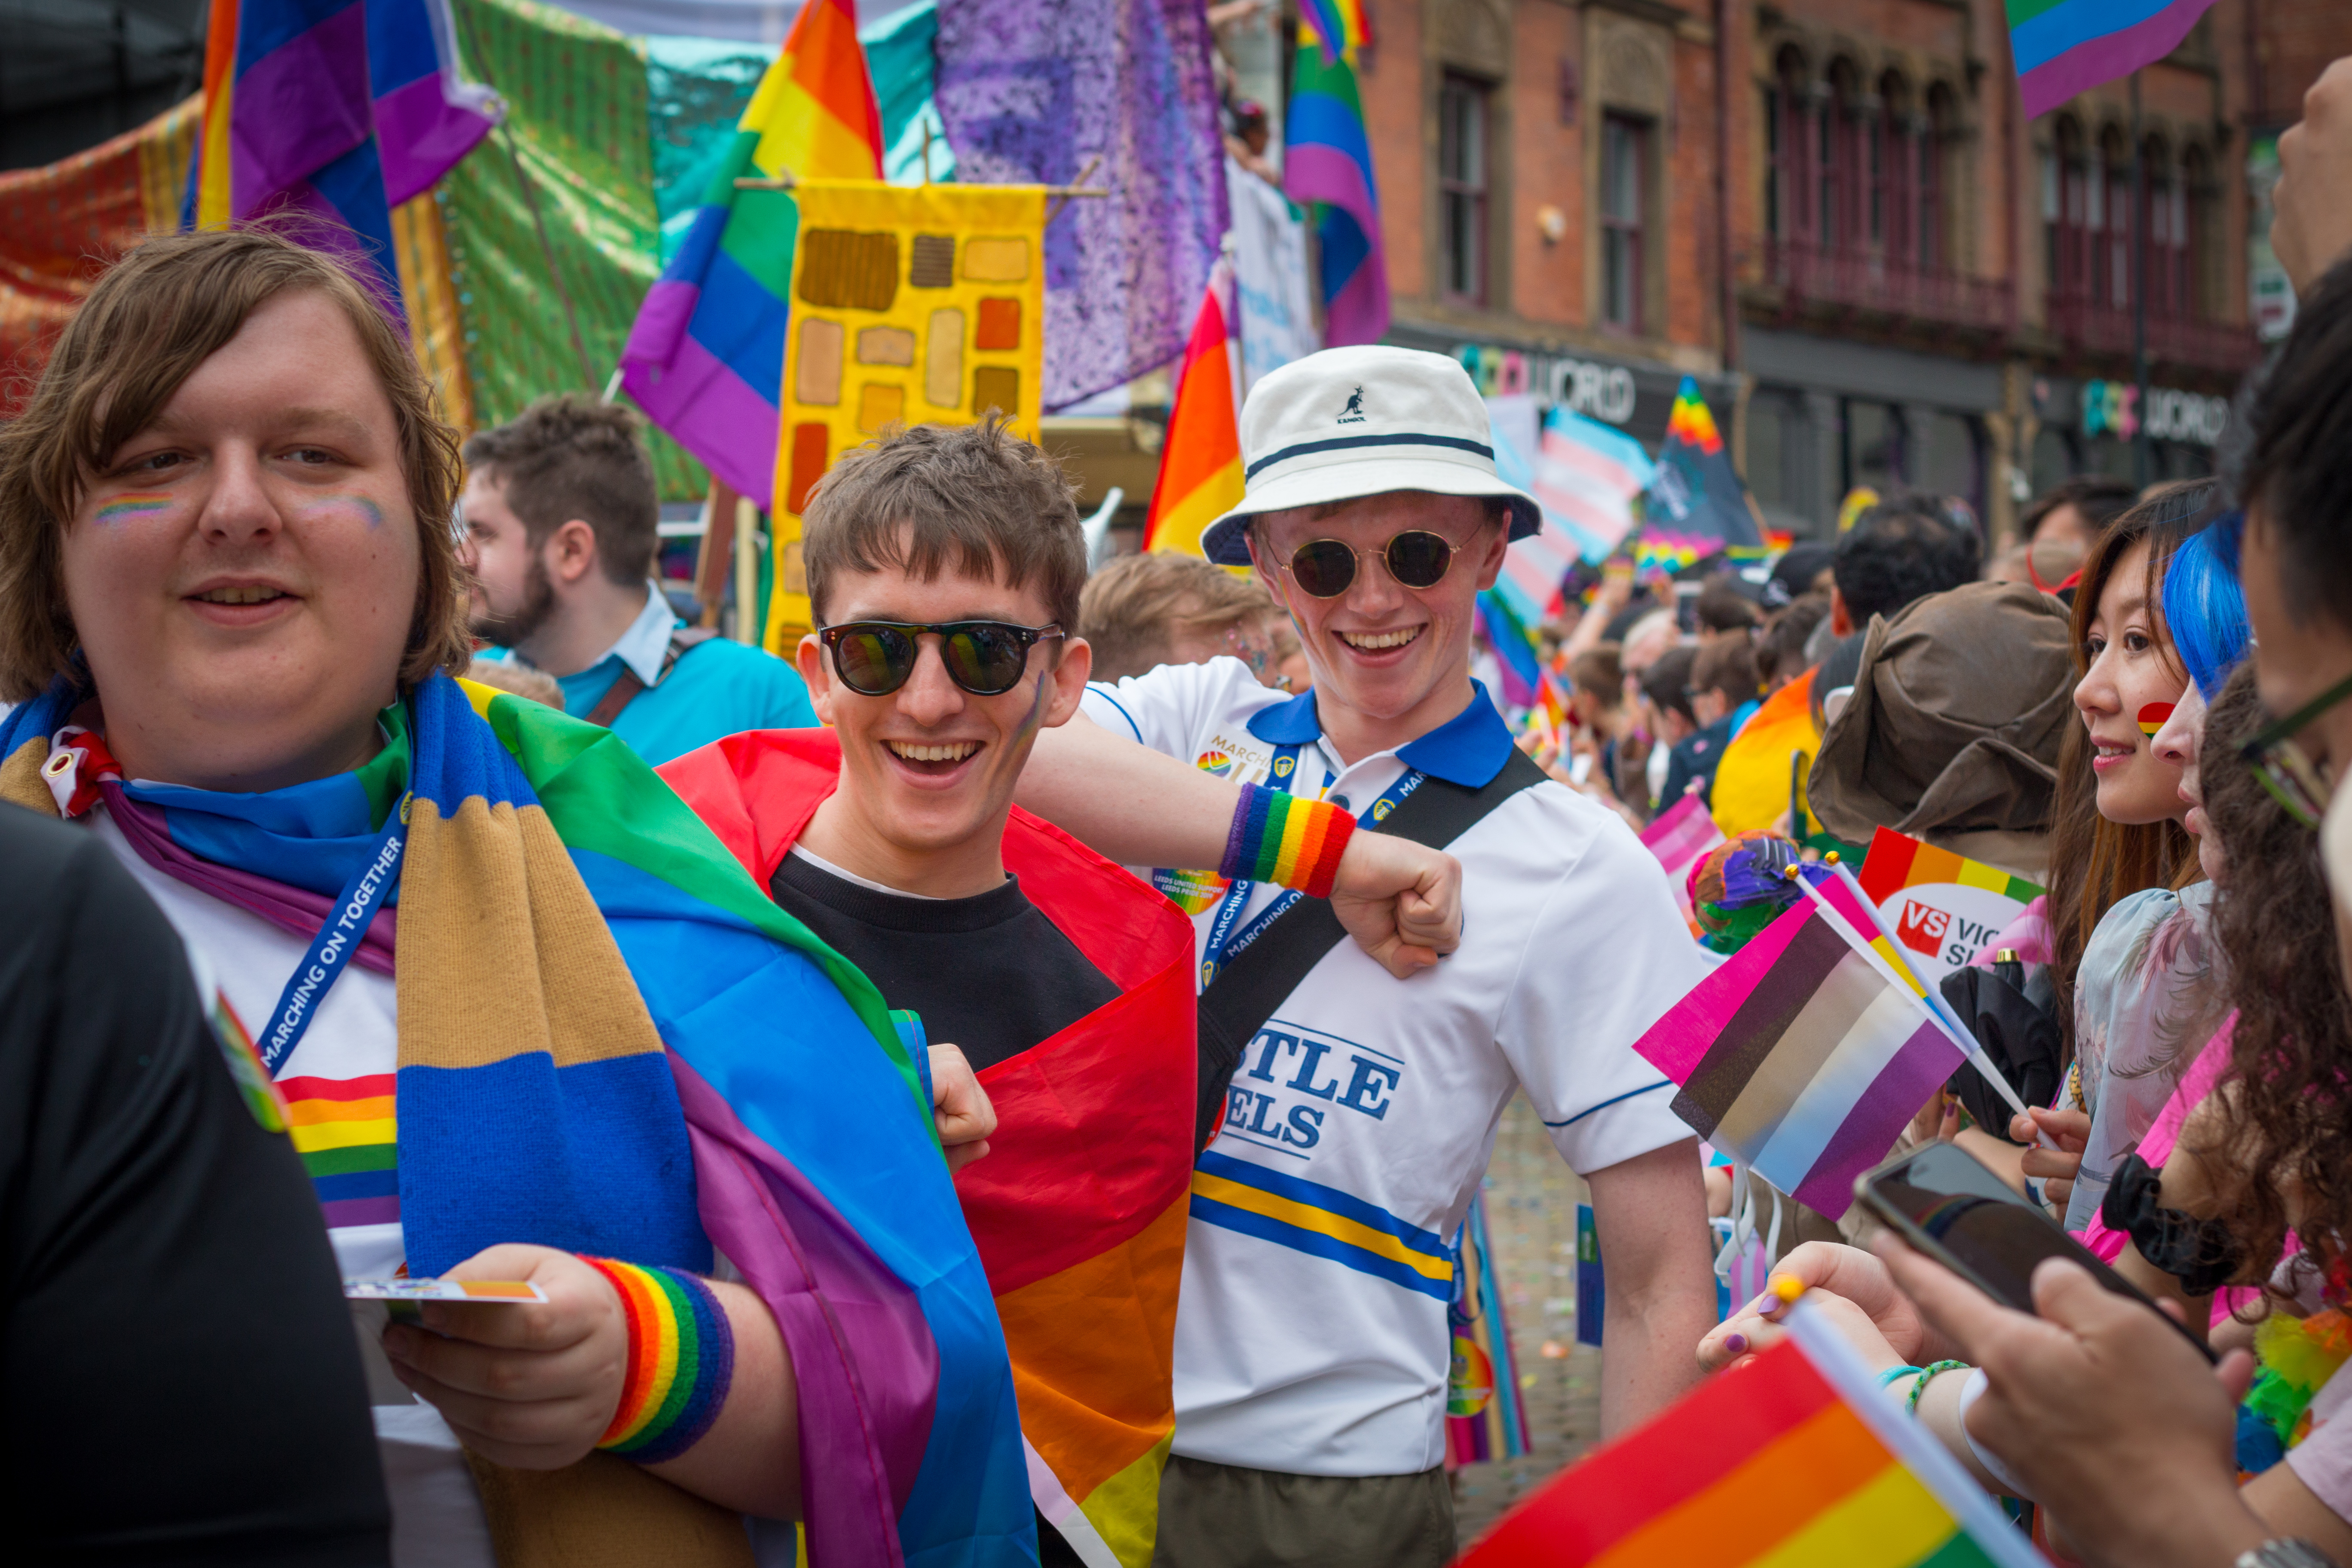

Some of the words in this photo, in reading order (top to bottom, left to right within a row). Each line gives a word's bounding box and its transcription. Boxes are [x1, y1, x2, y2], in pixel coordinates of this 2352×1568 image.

[1154, 875, 1173, 885] LEEDS
[1174, 880, 1197, 889] UNITED
[1161, 884, 1180, 893] LEEDS
[1210, 880, 1248, 949] MARCHING
[1227, 901, 1290, 957] MARCHING
[1906, 902, 1948, 938] VS
[260, 965, 326, 1069] MARCHING
[320, 930, 346, 965] ON
[338, 836, 402, 931] TOGETHER
[1237, 1028, 1400, 1121] TLE
